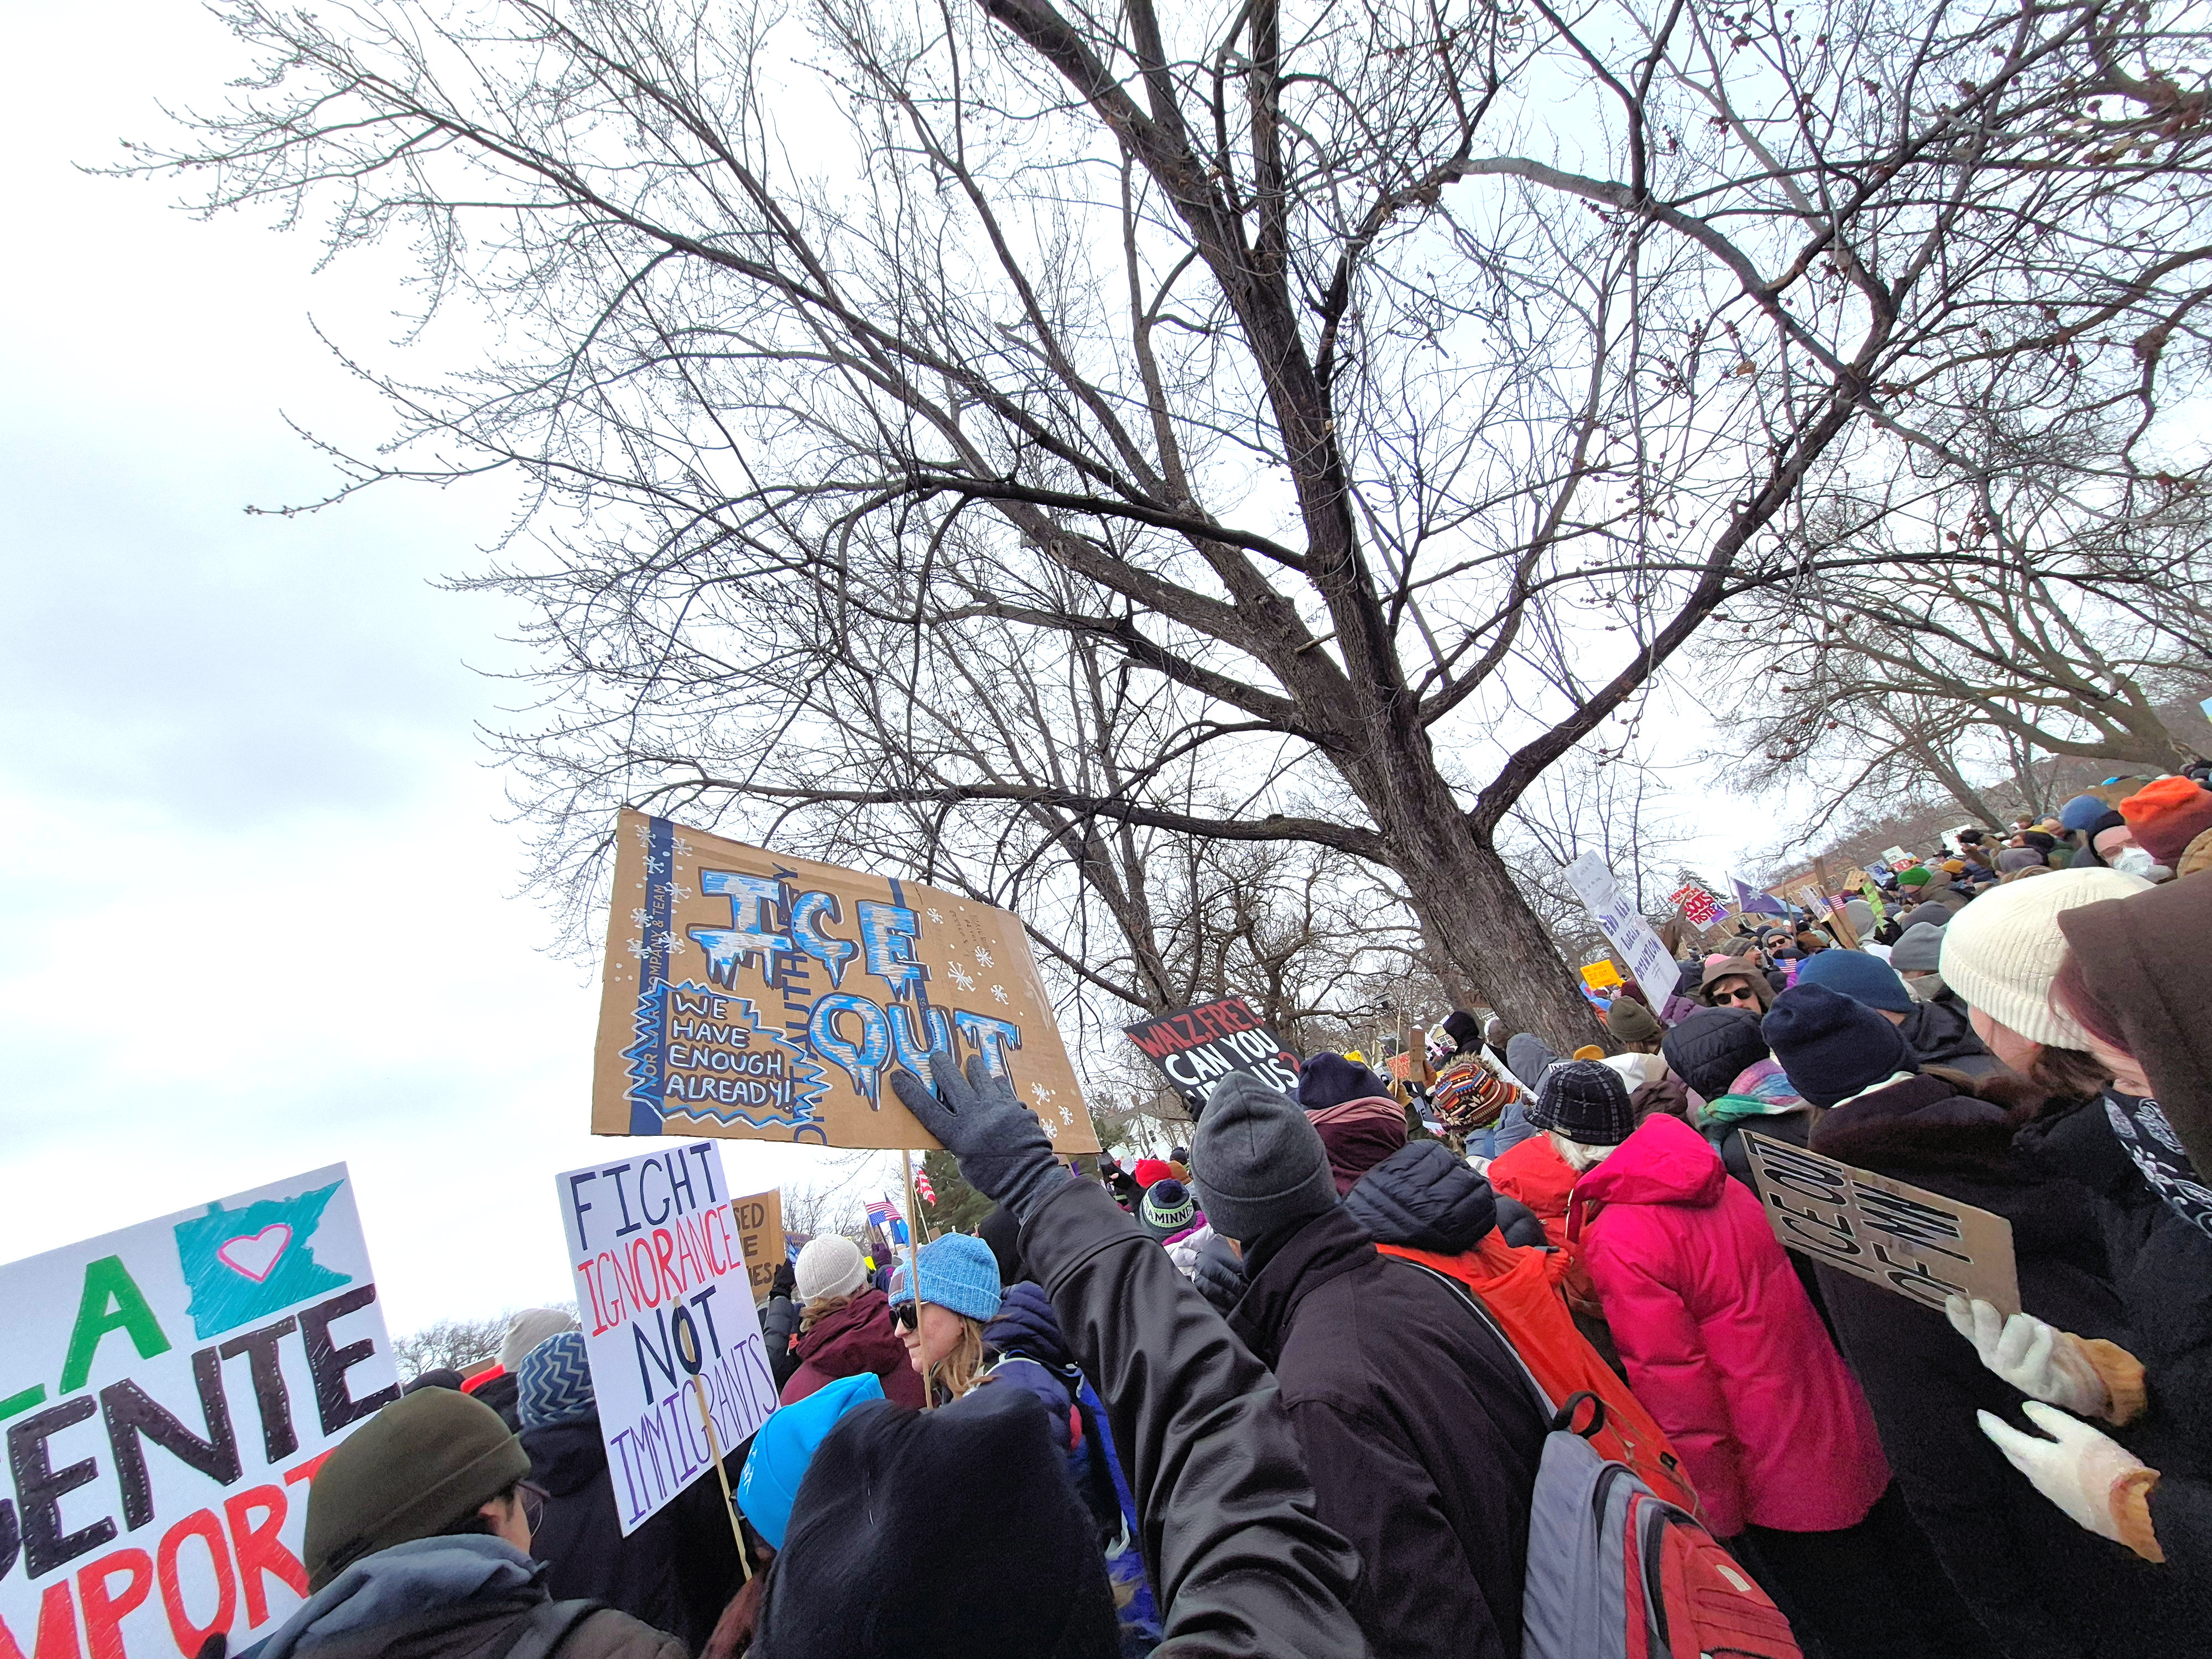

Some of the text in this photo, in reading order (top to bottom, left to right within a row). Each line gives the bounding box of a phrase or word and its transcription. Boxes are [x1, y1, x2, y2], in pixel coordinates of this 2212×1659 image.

[651, 920, 664, 928] &
[652, 884, 665, 915] TEAM
[686, 867, 932, 1001] ICE
[1634, 937, 1661, 982] DETENTION
[673, 993, 728, 1019] WE
[673, 1017, 749, 1048] HAVE
[669, 1044, 784, 1077] ENOUGH
[806, 992, 1022, 1110] OUT
[1165, 1027, 1280, 1085] CAN YOU
[666, 1073, 792, 1113] ALREADY!
[570, 1142, 717, 1251] FIGHT
[1743, 1130, 1876, 1273] ICE OUT
[578, 1203, 741, 1337] IGNORANCE
[632, 1285, 722, 1405] NOT
[611, 1333, 777, 1526] IMMIGRANTS
